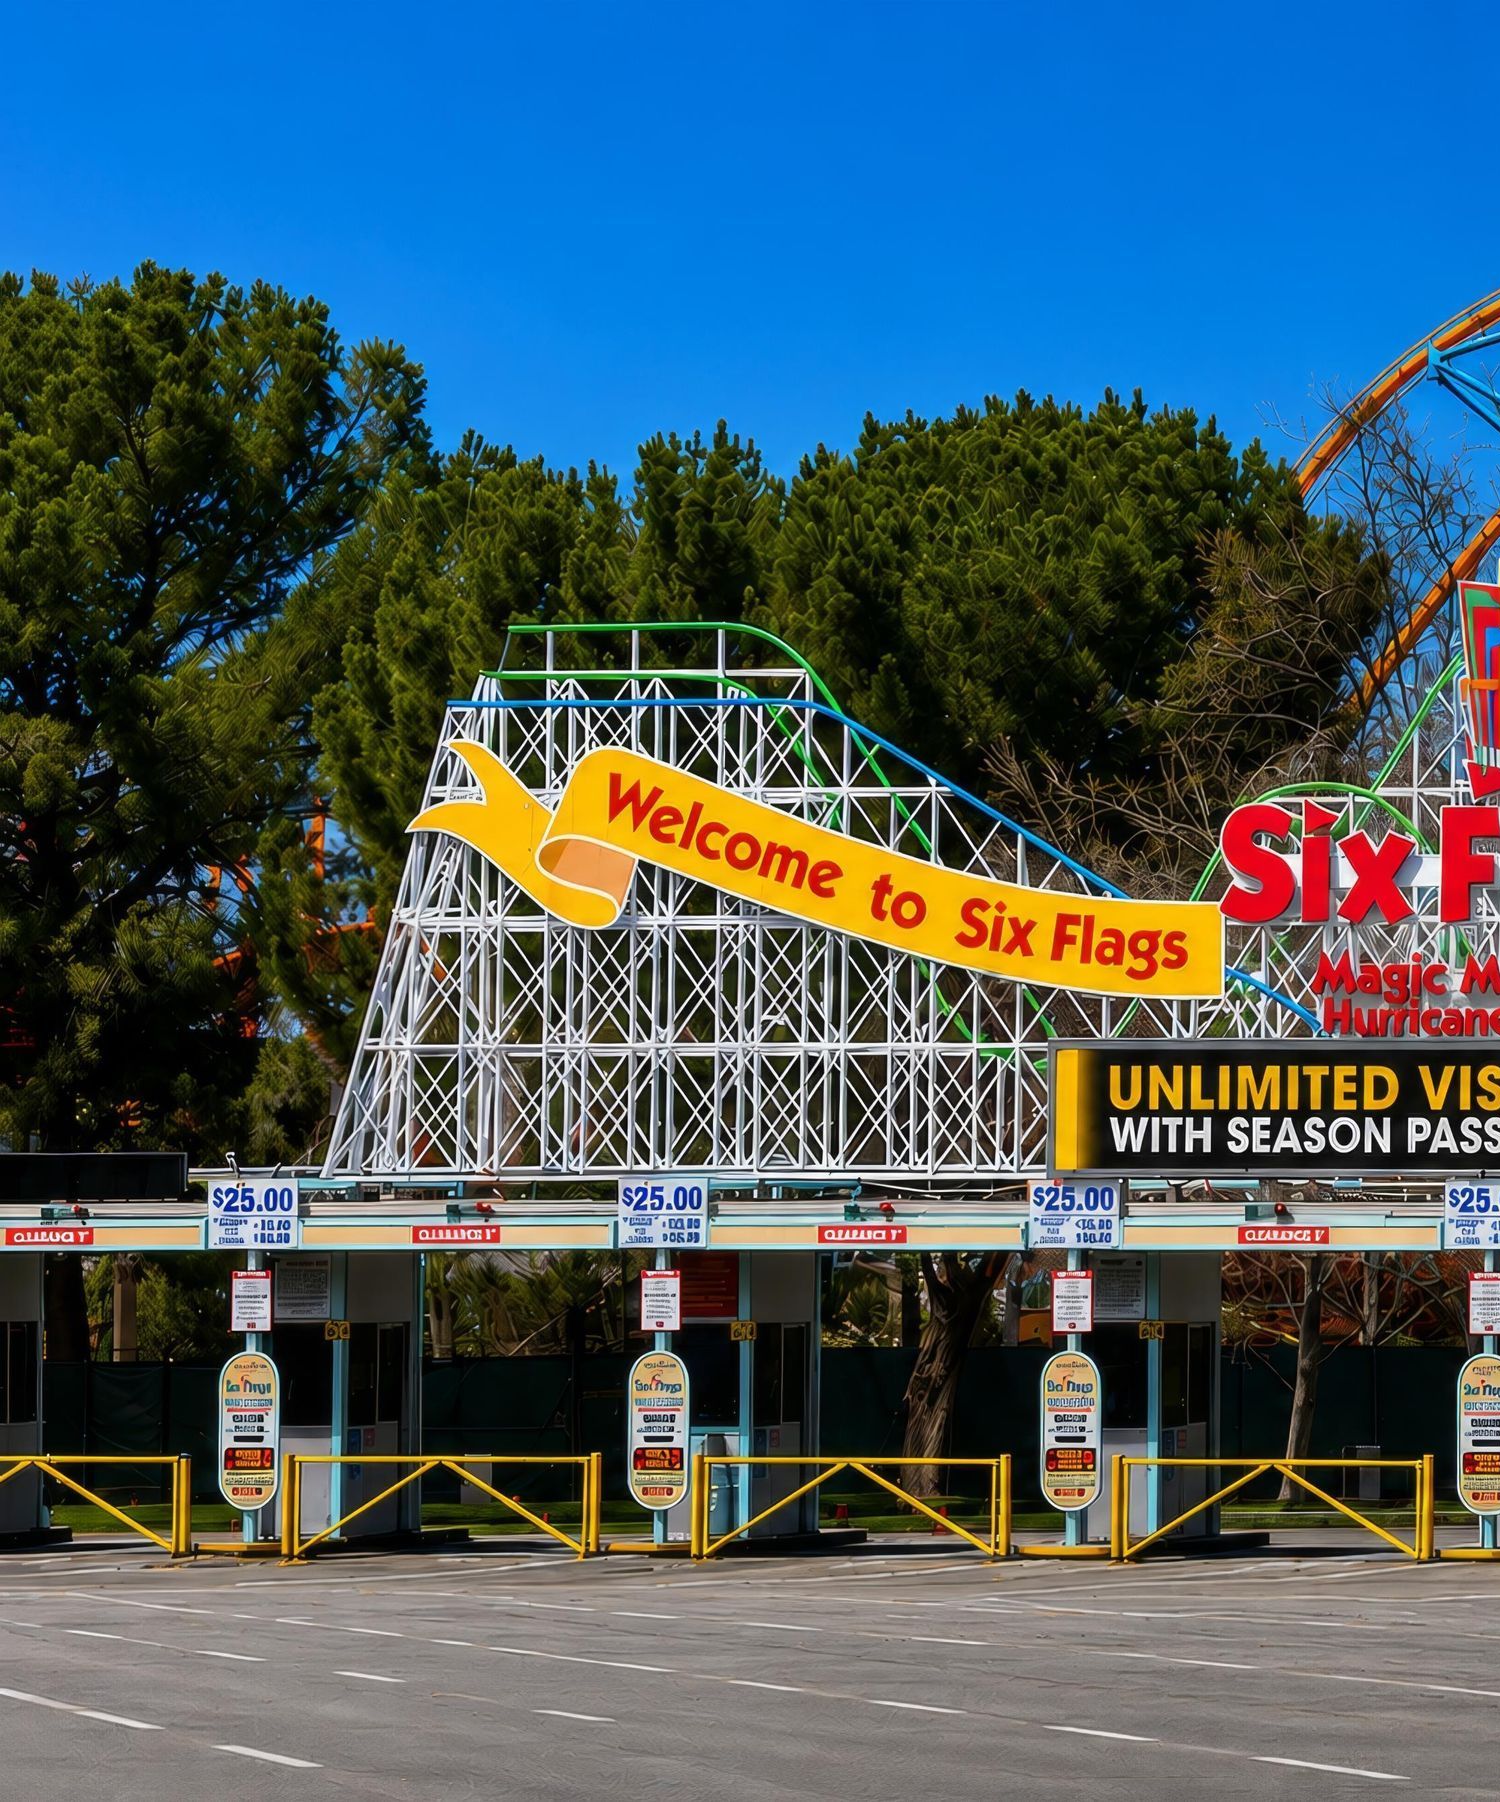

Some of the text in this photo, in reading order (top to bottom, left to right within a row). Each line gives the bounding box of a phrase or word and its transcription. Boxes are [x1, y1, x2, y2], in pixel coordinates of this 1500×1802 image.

[609, 773, 1188, 980] Welcome to Six Flags
[1219, 799, 1415, 925] Six
[1309, 949, 1448, 1006] Magic
[1109, 1065, 1399, 1110] UNLIMITED
[1109, 1116, 1212, 1153] WITH
[1227, 1116, 1391, 1154] SEASON
[212, 1187, 293, 1213] $25.00
[621, 1186, 703, 1211] $25.00
[1033, 1186, 1114, 1212] $25.00
